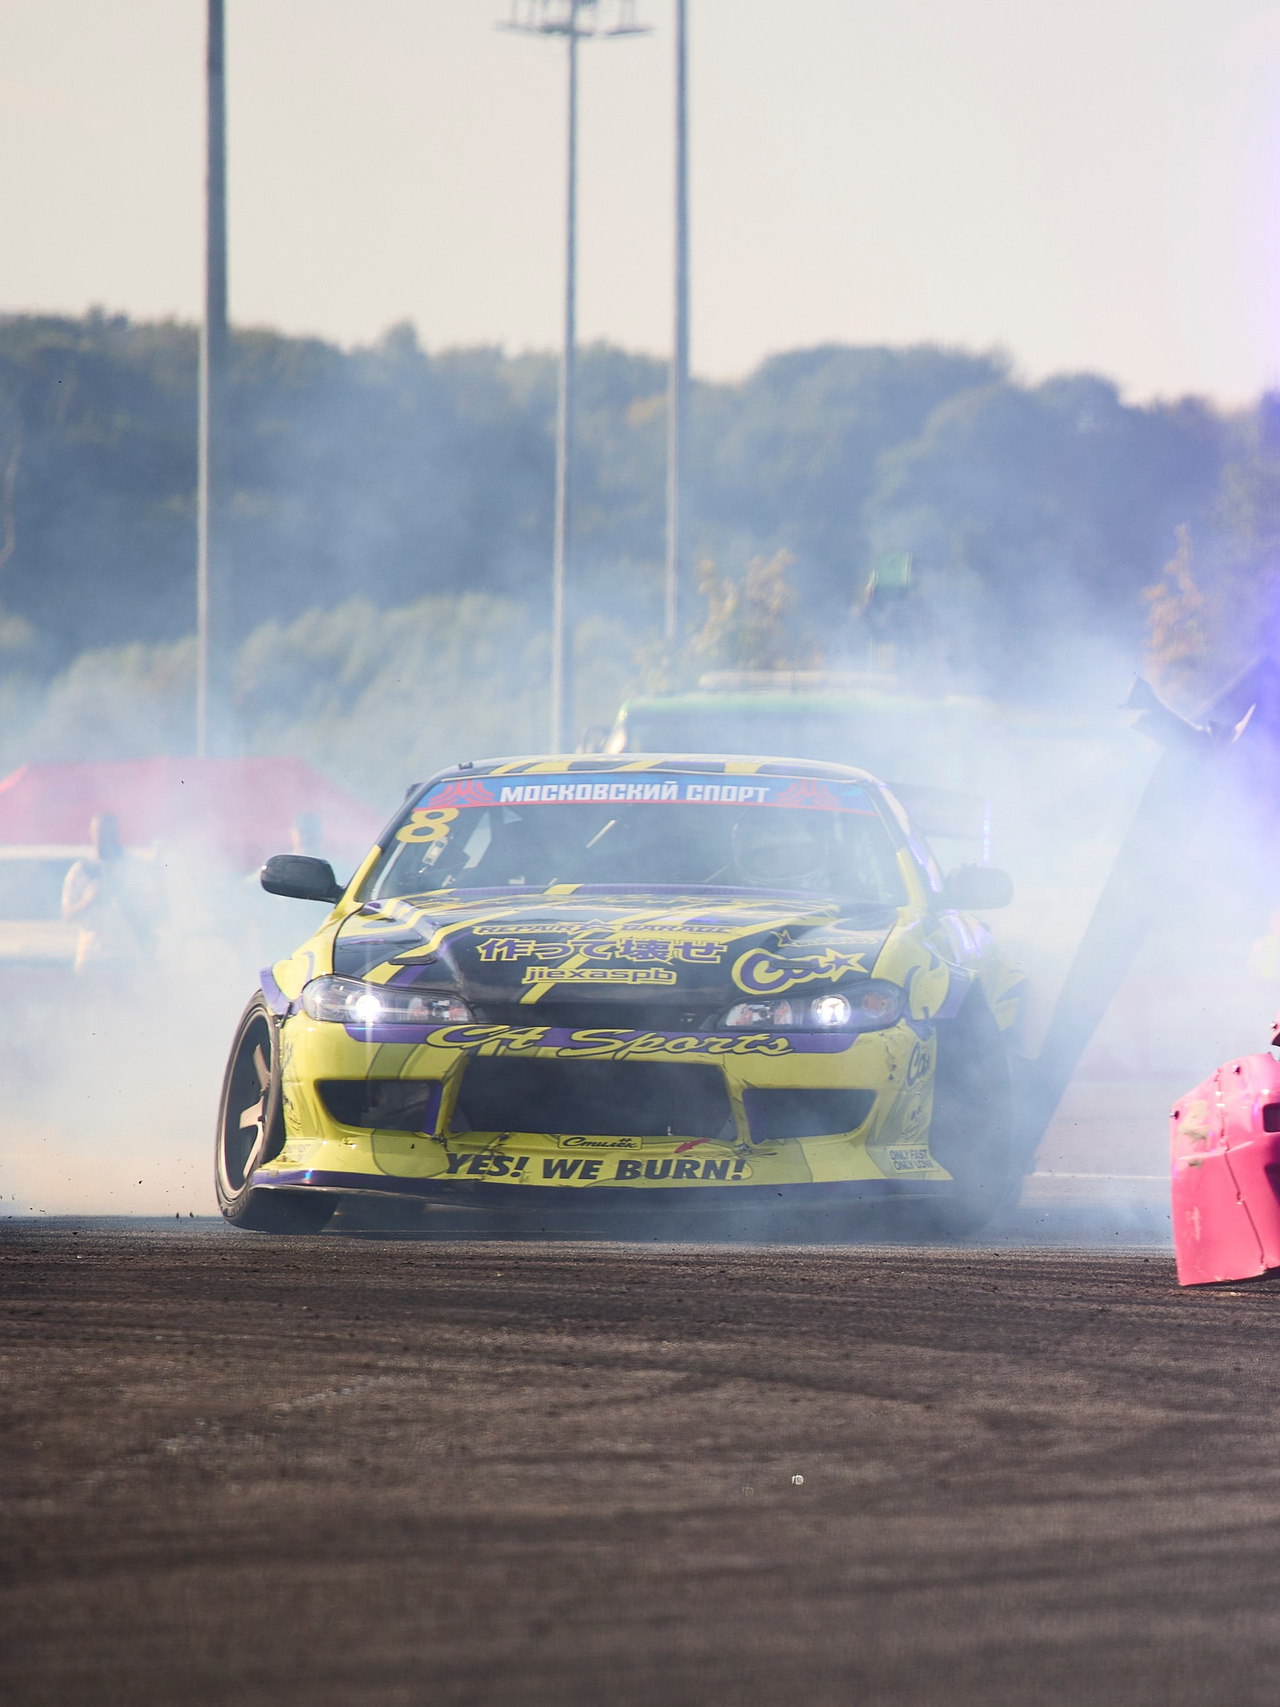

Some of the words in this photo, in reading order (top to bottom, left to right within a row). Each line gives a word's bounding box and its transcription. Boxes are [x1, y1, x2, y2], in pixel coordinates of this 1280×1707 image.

[500, 781, 679, 803] МОСКОВСКИЙ
[685, 784, 771, 804] СПОРТ
[395, 807, 460, 843] 8
[476, 925, 574, 934] REPAIR
[621, 925, 730, 934] GARAGE
[477, 938, 728, 964] 作って壊せ
[523, 967, 675, 983] jiexaspb
[425, 1024, 552, 1049] CA
[556, 1028, 795, 1060] Sports
[446, 1153, 530, 1178] YES!
[542, 1158, 604, 1180] WE
[614, 1158, 748, 1181] BURN!
